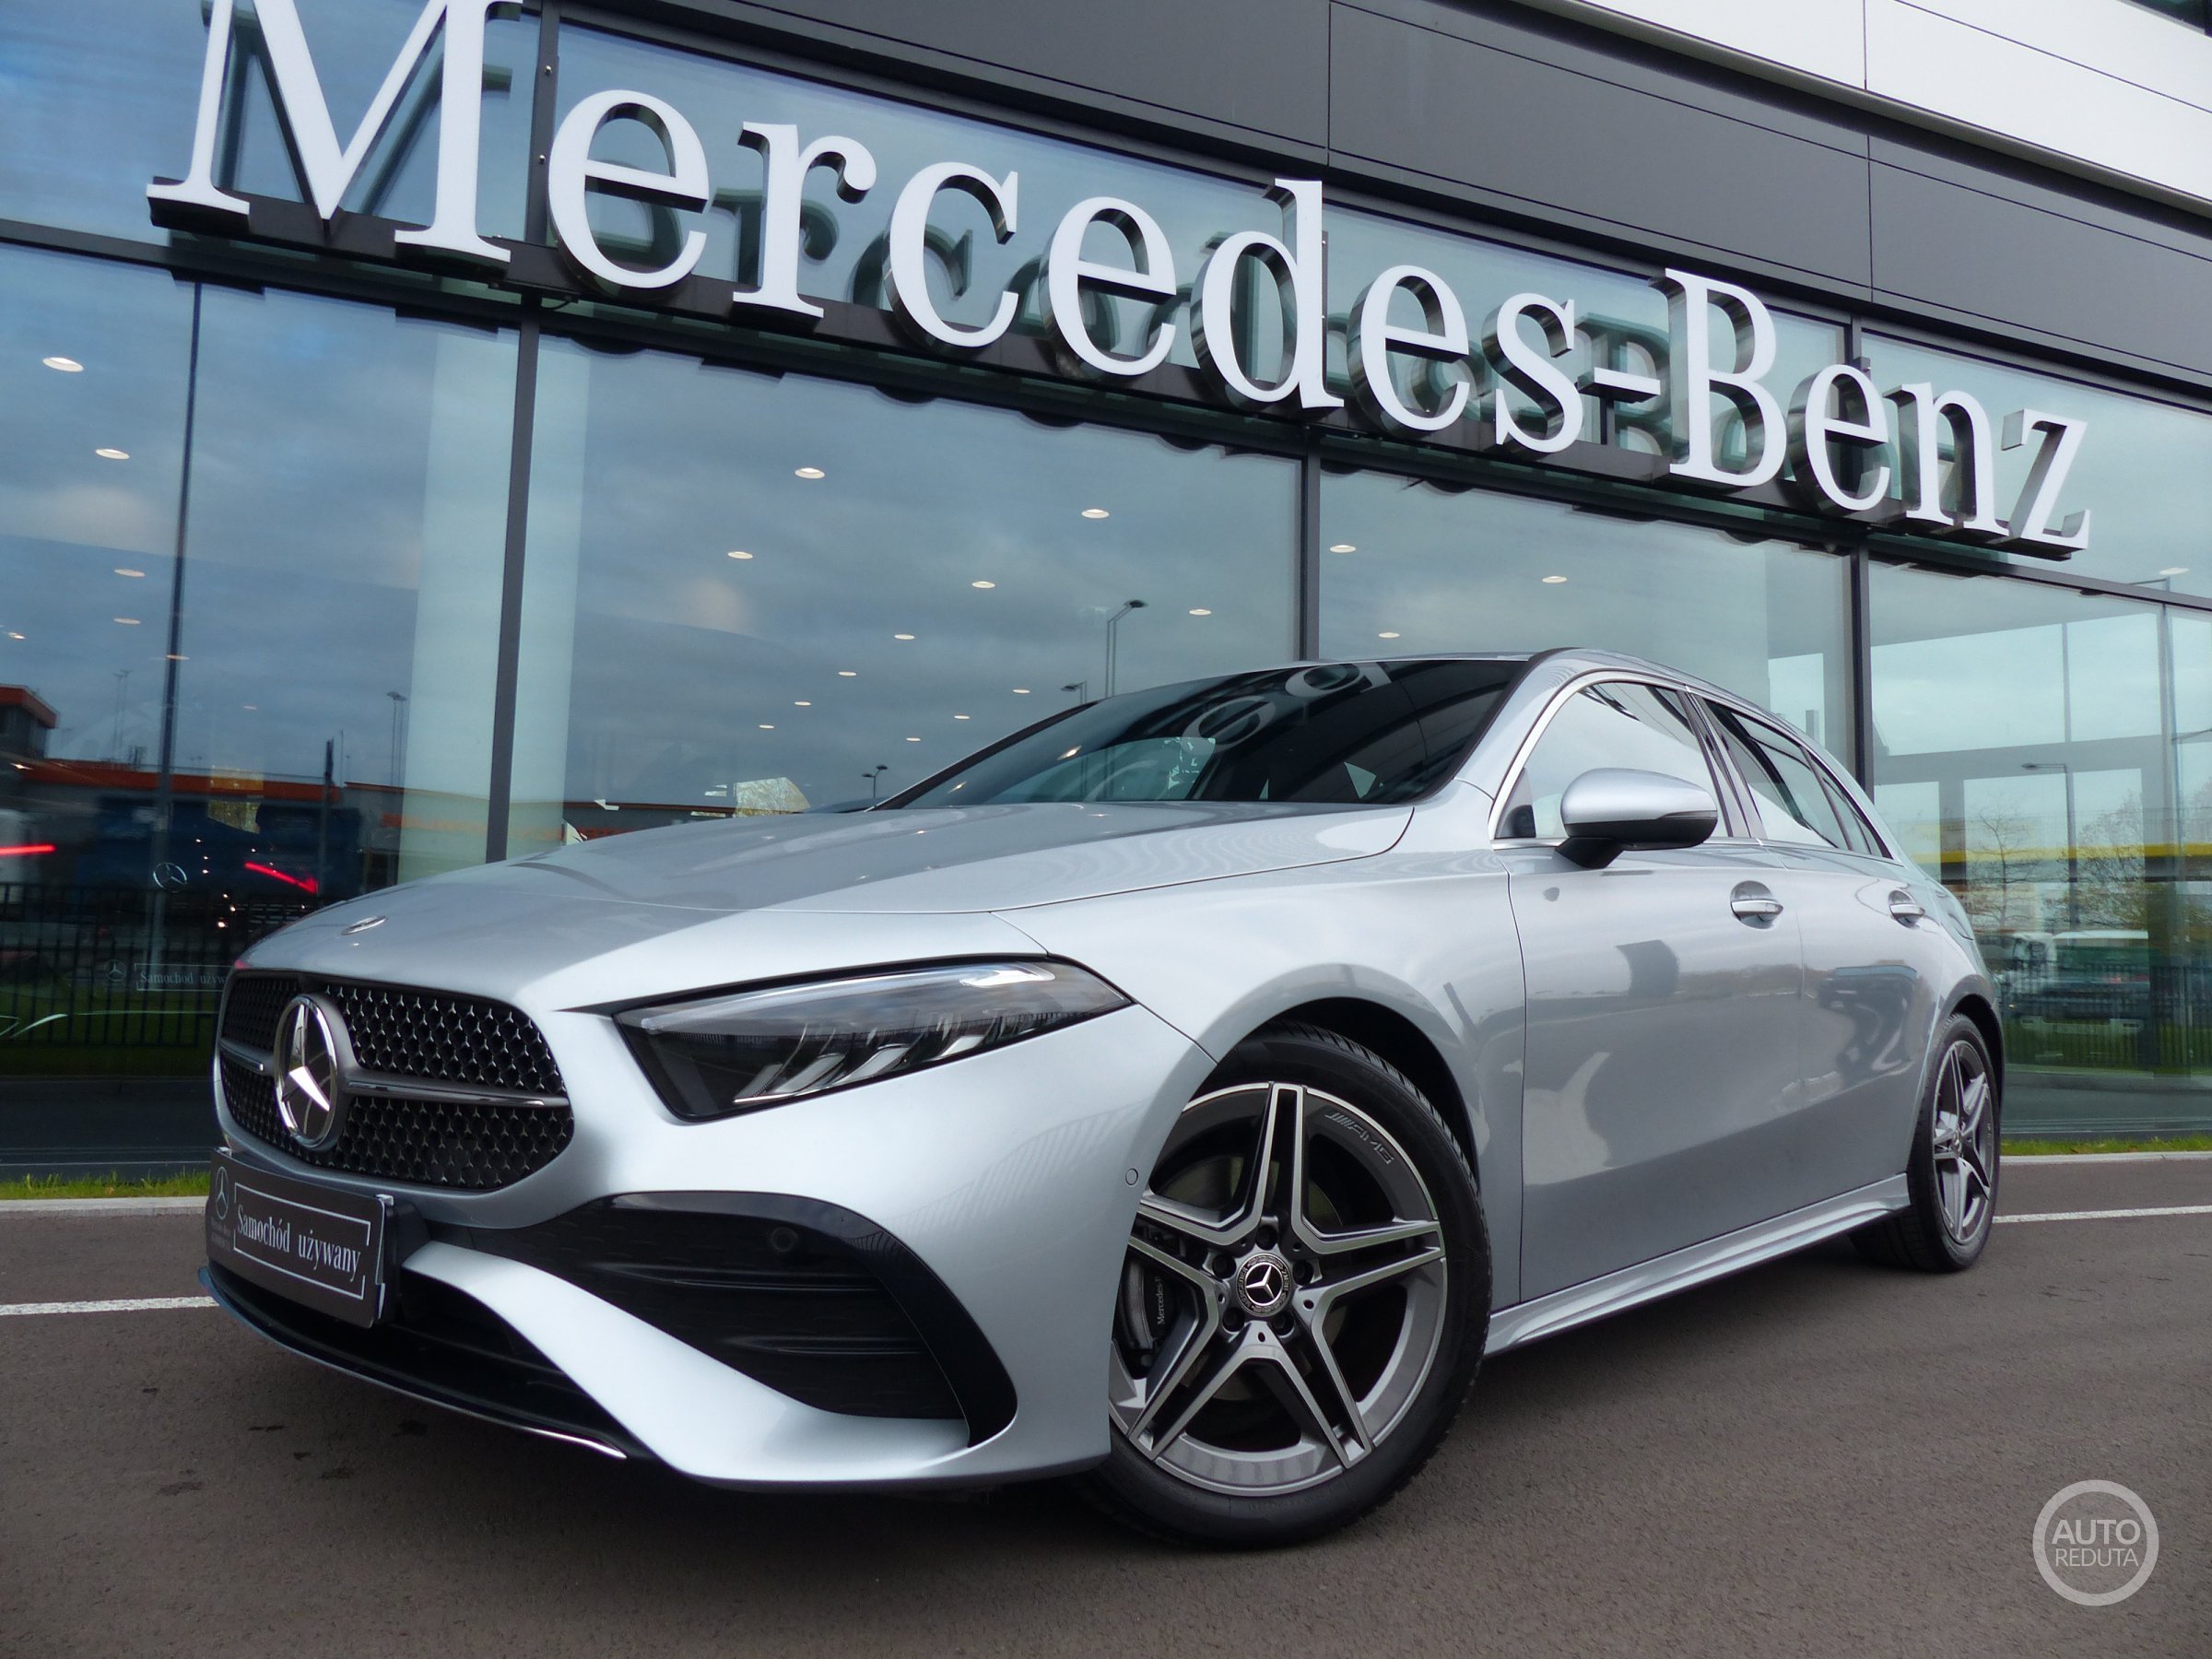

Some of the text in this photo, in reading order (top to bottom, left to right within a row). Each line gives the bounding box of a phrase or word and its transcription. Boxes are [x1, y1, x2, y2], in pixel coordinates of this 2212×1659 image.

[146, 0, 2091, 551] Mercedes-Benz
[238, 1205, 290, 1253] Samochód
[298, 1229, 361, 1283] używany
